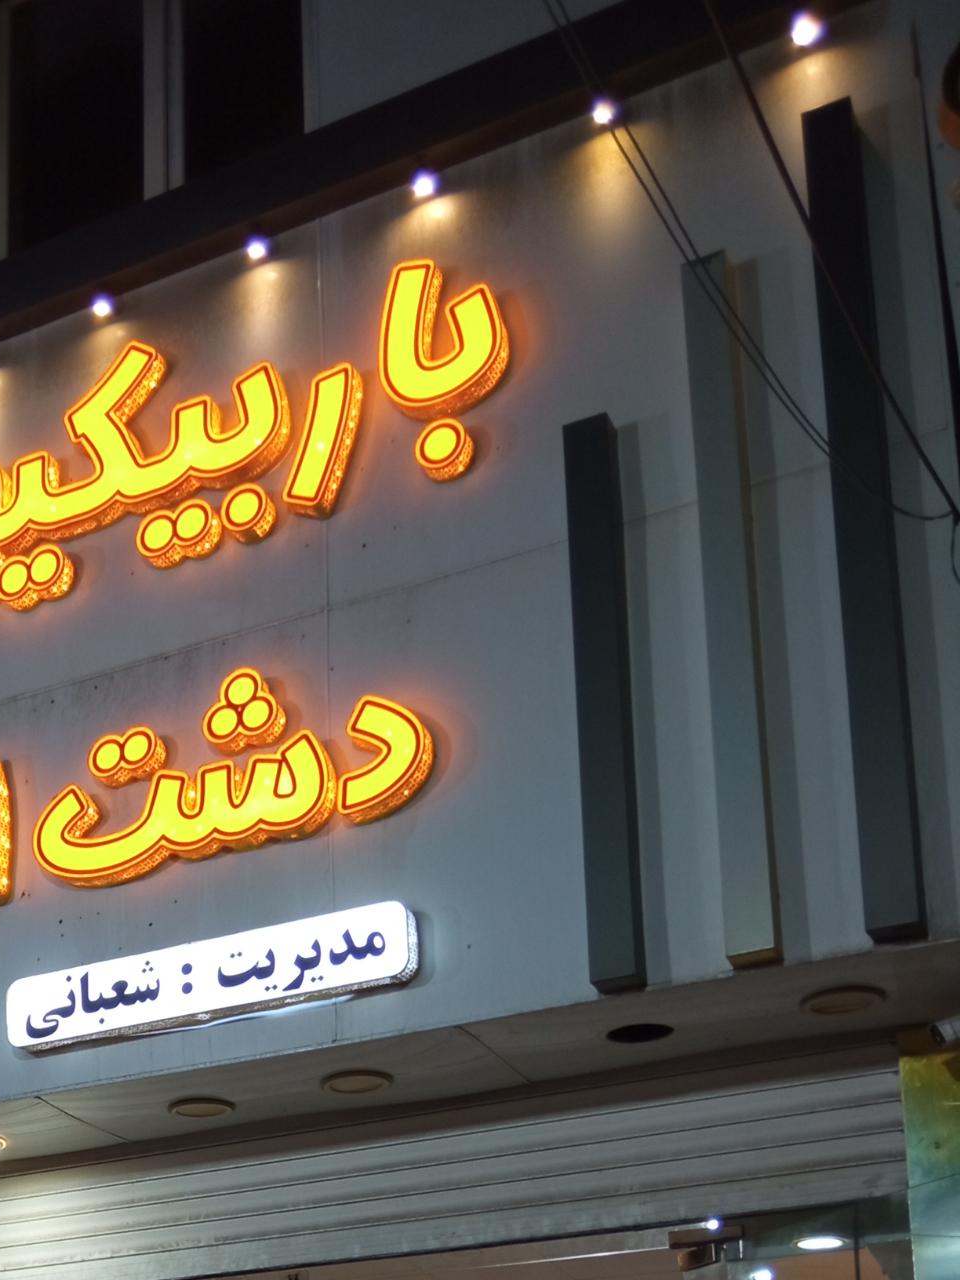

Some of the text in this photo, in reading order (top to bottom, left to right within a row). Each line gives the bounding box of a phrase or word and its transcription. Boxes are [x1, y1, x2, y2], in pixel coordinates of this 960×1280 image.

[34, 668, 434, 885] دشت
[25, 958, 161, 1039] شعبانی
[216, 926, 387, 992] مدیریت
